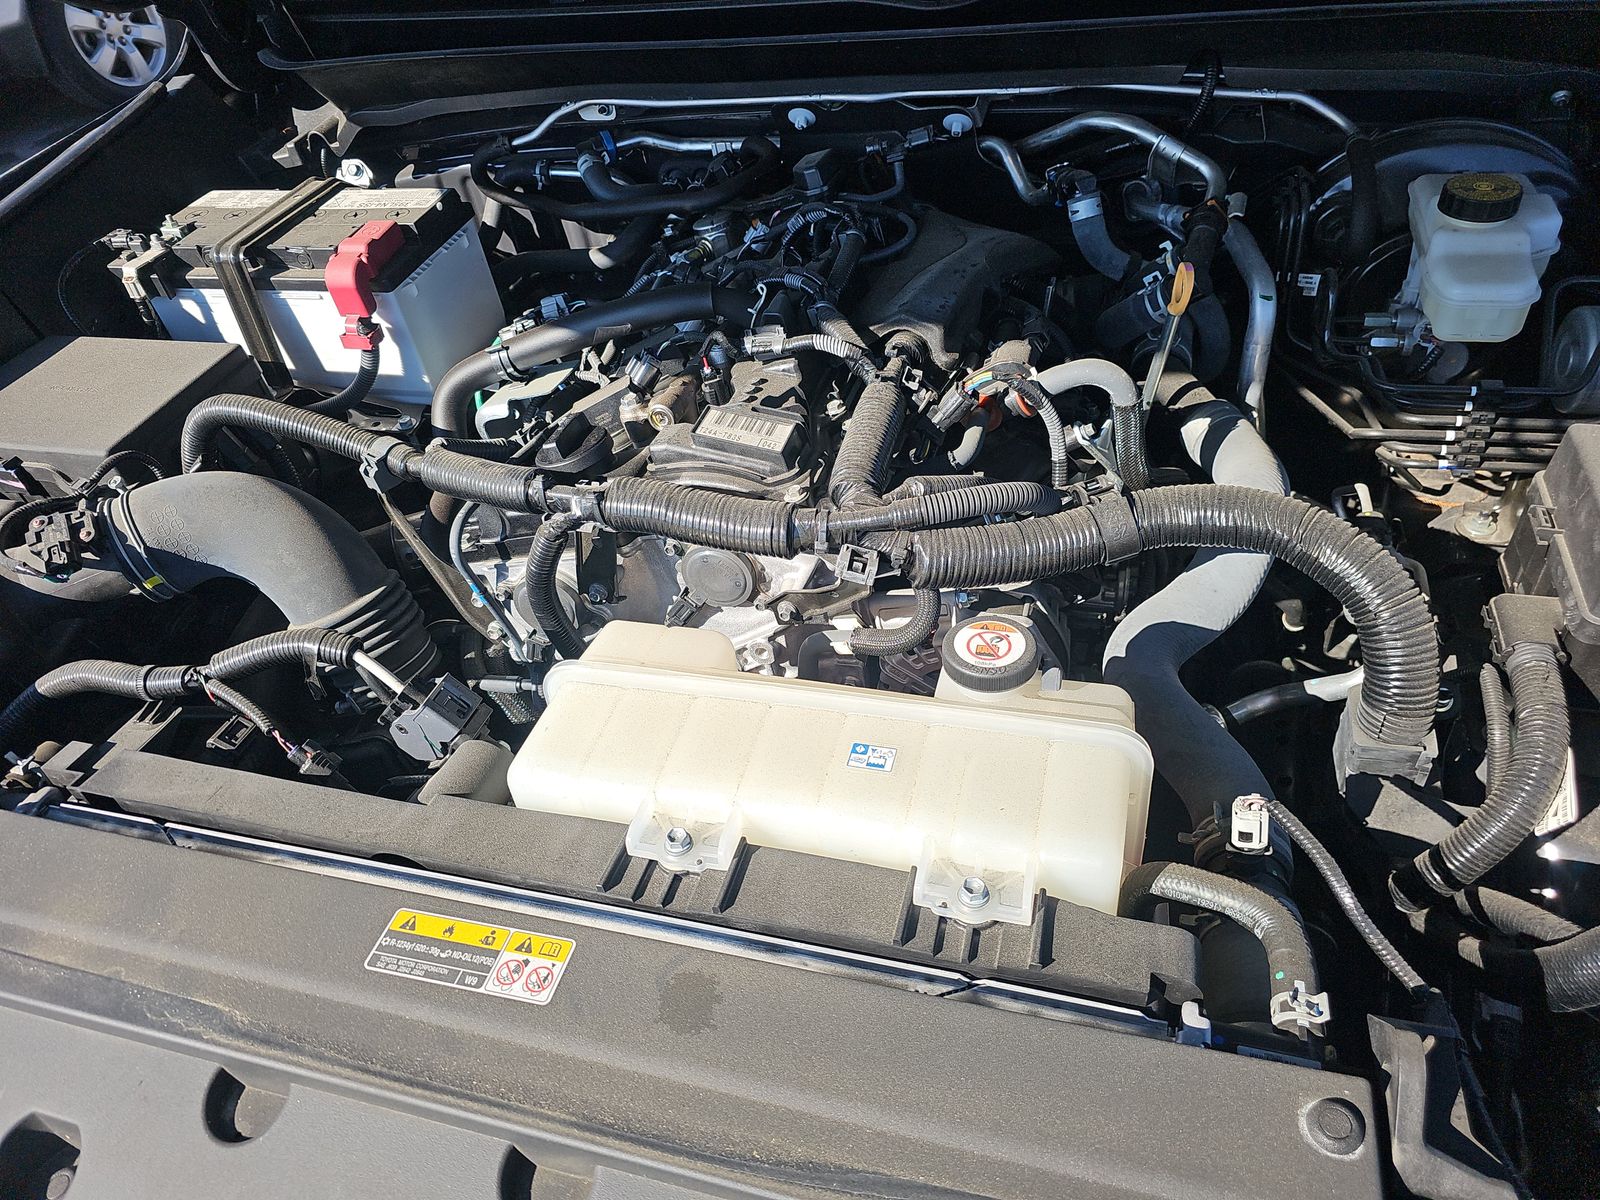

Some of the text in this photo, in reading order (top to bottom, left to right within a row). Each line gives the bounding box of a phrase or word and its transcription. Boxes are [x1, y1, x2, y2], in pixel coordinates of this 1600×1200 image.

[762, 440, 777, 450] 042
[380, 956, 449, 975] TOYOTA MOTOR CORPORATION
[464, 975, 478, 985] W9
